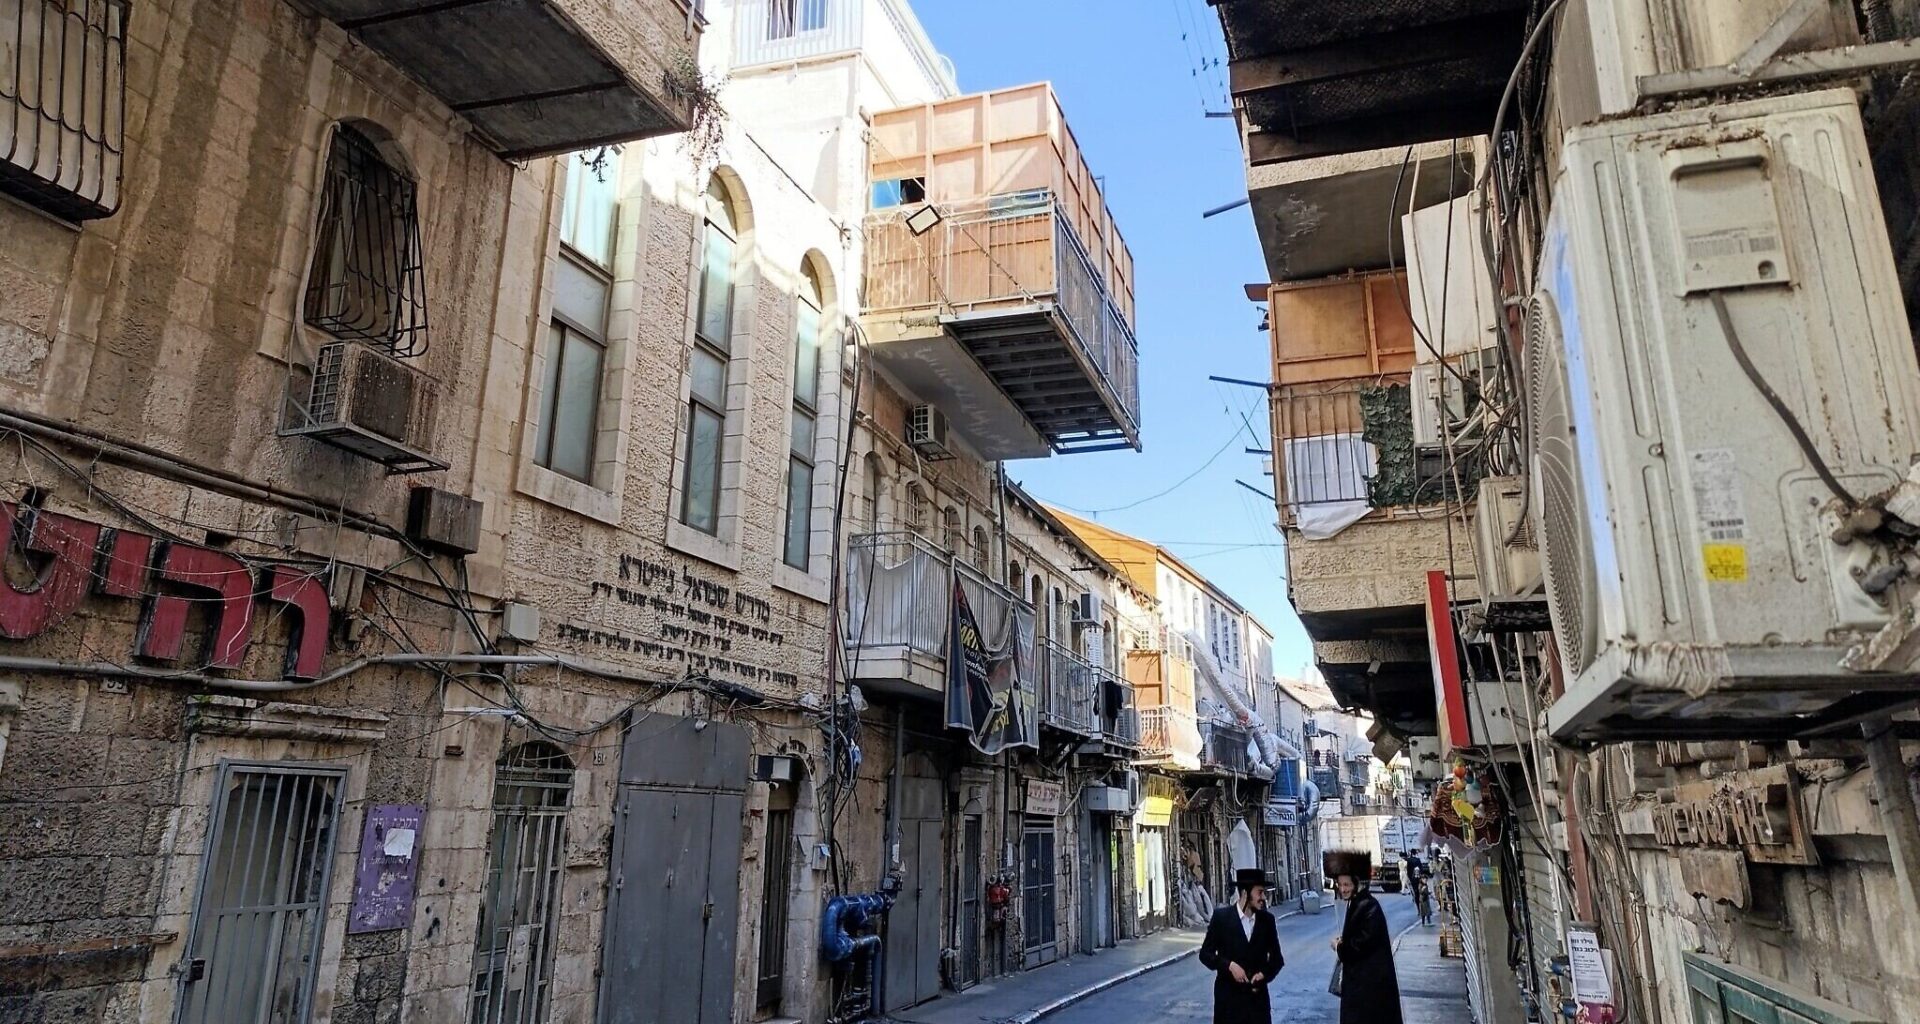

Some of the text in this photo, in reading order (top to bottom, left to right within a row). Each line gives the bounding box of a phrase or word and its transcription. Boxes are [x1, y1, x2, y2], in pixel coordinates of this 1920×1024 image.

[619, 553, 771, 623] מדרש שמואל נייטרא
